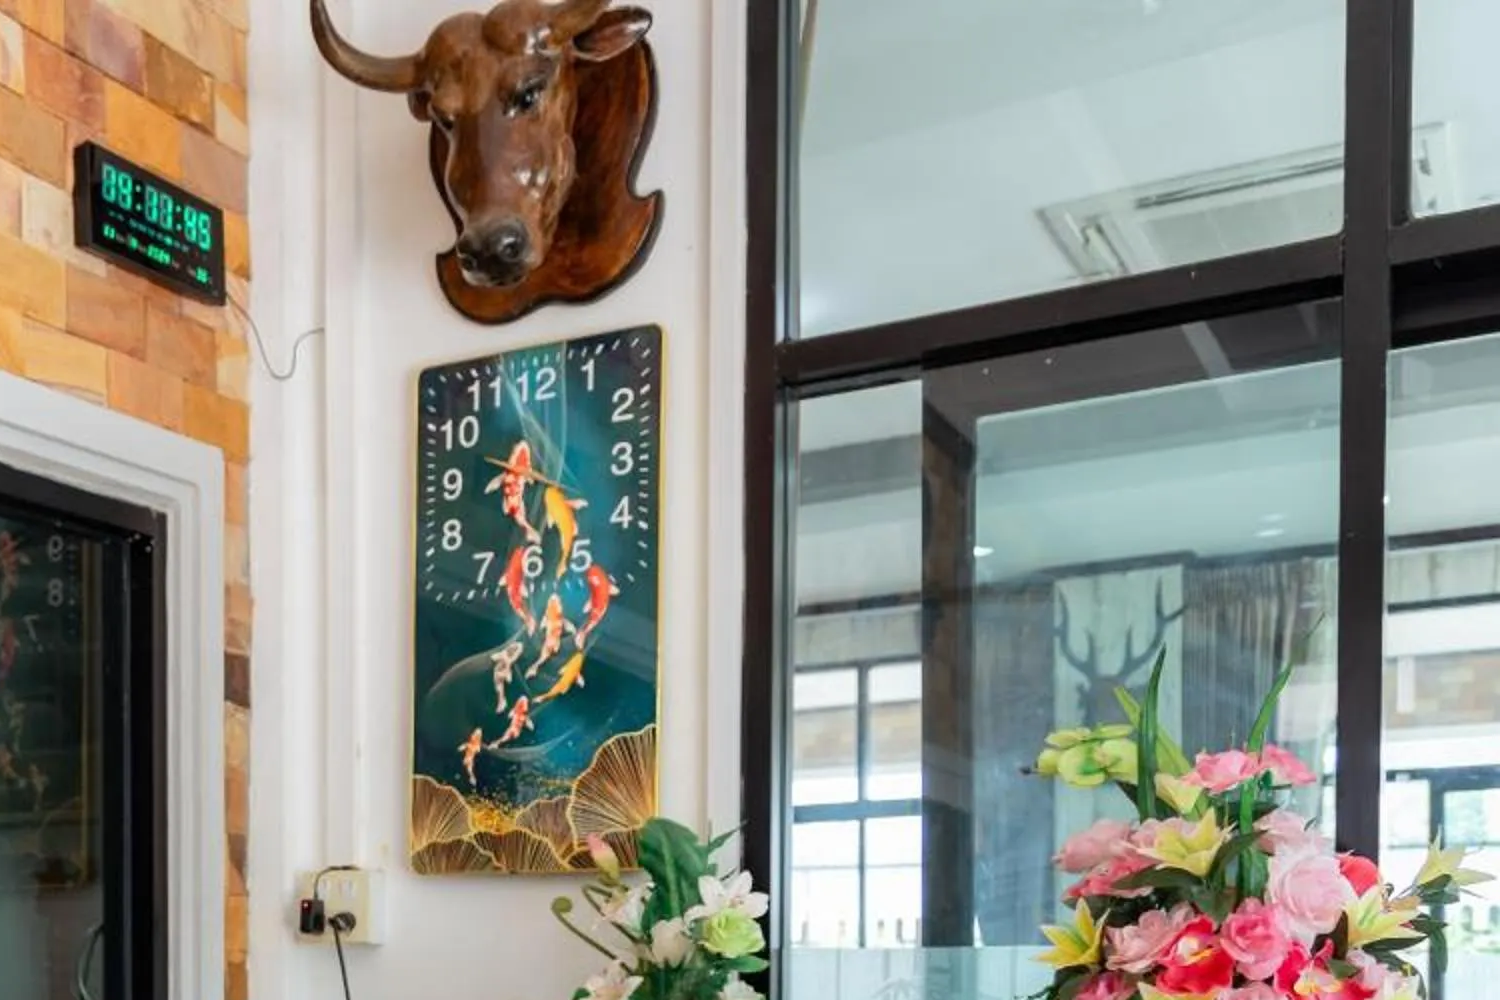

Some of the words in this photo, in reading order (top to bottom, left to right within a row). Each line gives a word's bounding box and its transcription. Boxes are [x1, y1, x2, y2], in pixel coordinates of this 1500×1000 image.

[516, 366, 557, 404] 12
[580, 358, 595, 392] 1
[467, 376, 501, 412] 11
[611, 387, 635, 423] 2
[440, 415, 479, 451] 10
[611, 441, 633, 476] 3
[442, 468, 463, 500] 9
[609, 496, 633, 529] 4
[441, 519, 463, 551] 8
[472, 551, 494, 584] 7
[521, 545, 543, 578] 6
[570, 539, 592, 573] 5
